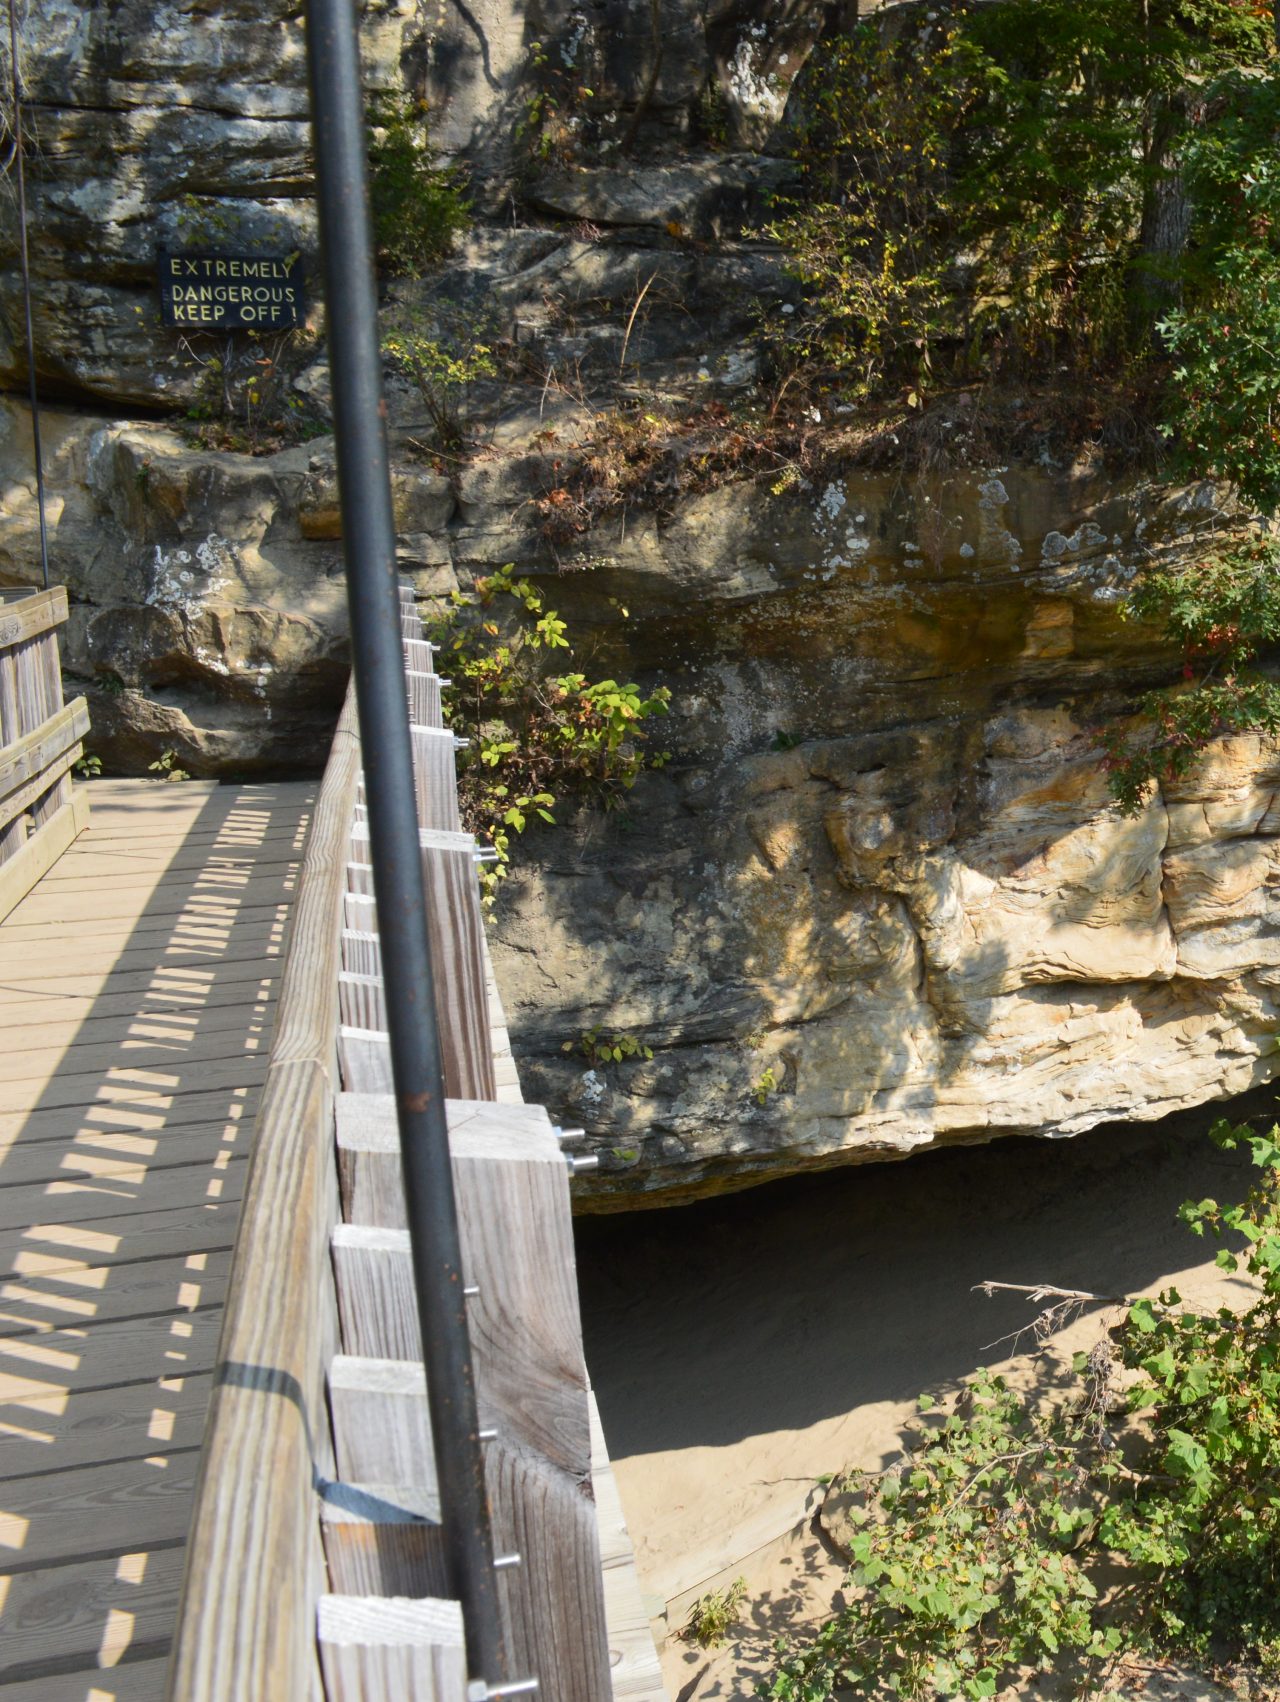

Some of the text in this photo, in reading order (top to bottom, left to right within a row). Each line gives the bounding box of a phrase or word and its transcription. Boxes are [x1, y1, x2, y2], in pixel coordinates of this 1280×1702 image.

[170, 258, 291, 278] EXTREMELY
[172, 285, 295, 303] DANGEROUS
[174, 305, 225, 321] KEEP
